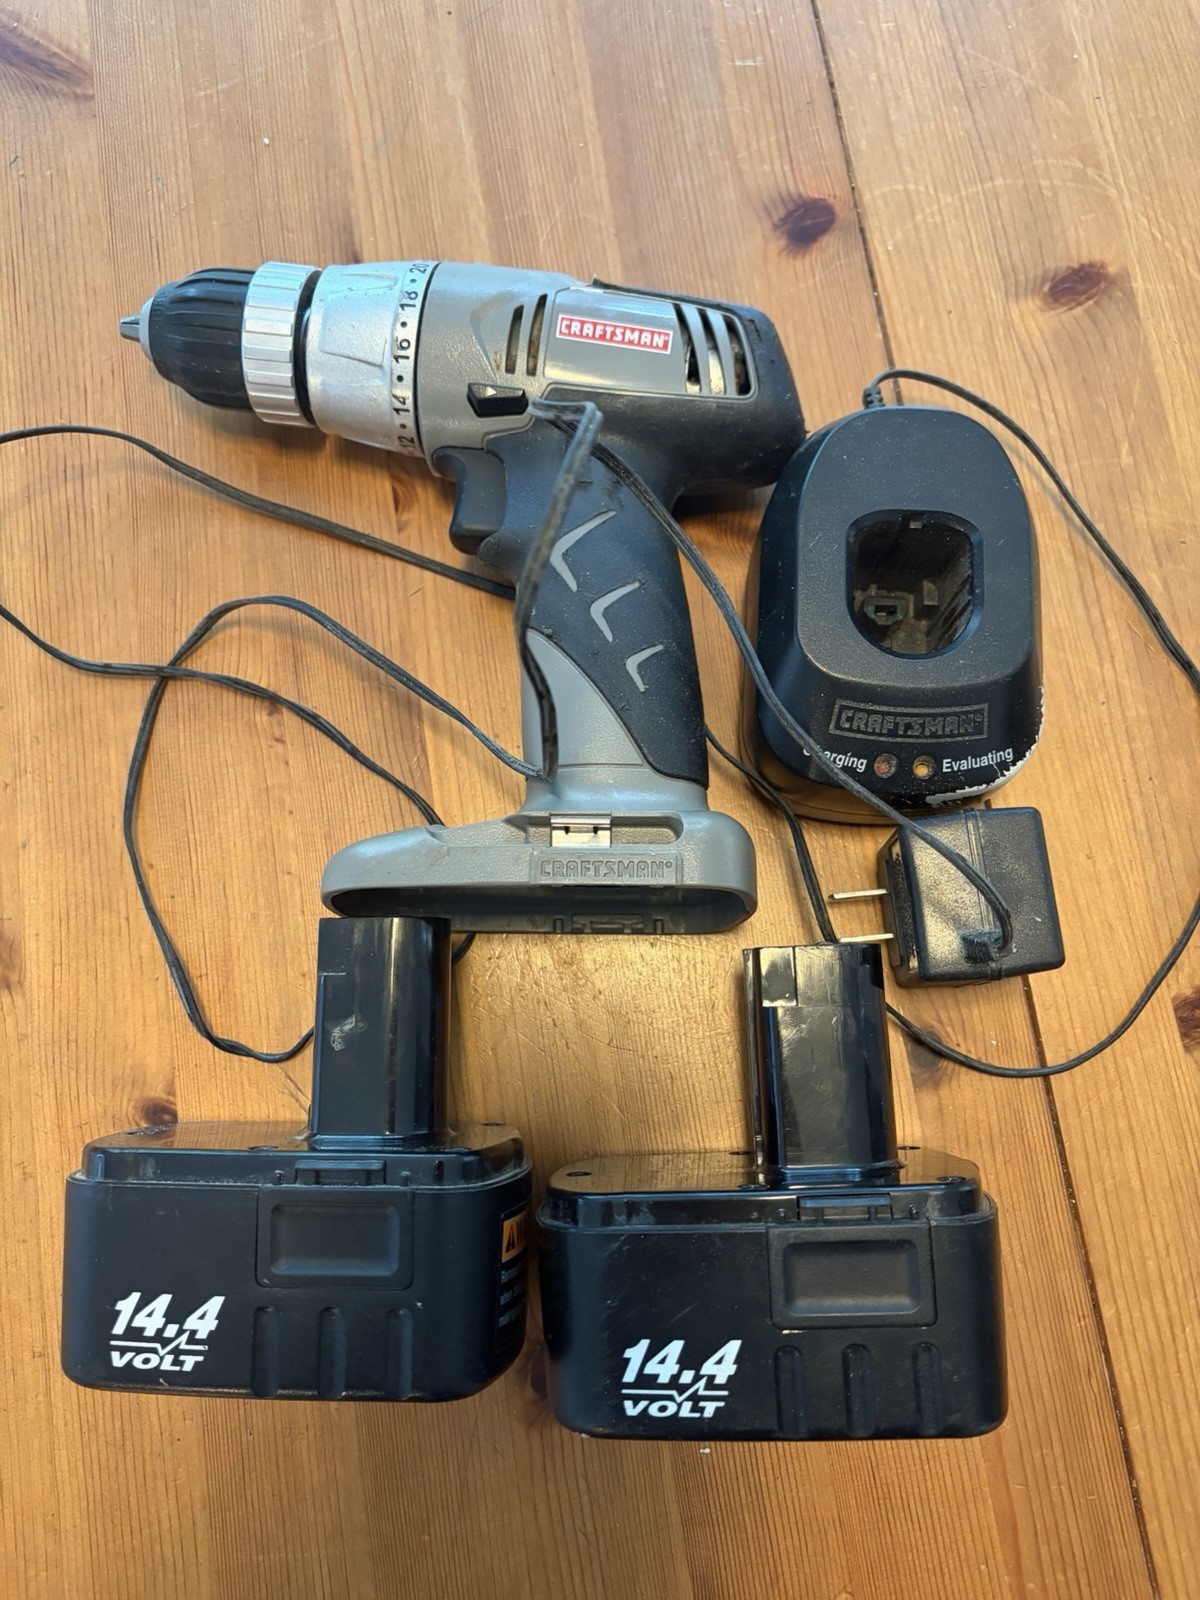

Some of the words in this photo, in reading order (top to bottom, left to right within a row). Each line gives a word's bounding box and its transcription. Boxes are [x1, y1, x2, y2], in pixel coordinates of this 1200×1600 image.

[409, 263, 430, 274] 20
[399, 290, 418, 312] 18
[393, 336, 411, 365] 16
[392, 393, 410, 415] 14
[942, 747, 1014, 773] Evaluating
[111, 1291, 226, 1339] 14.4
[110, 1351, 205, 1372] VOLT
[621, 1338, 743, 1384] 14.4
[623, 1400, 726, 1418] VOLT
